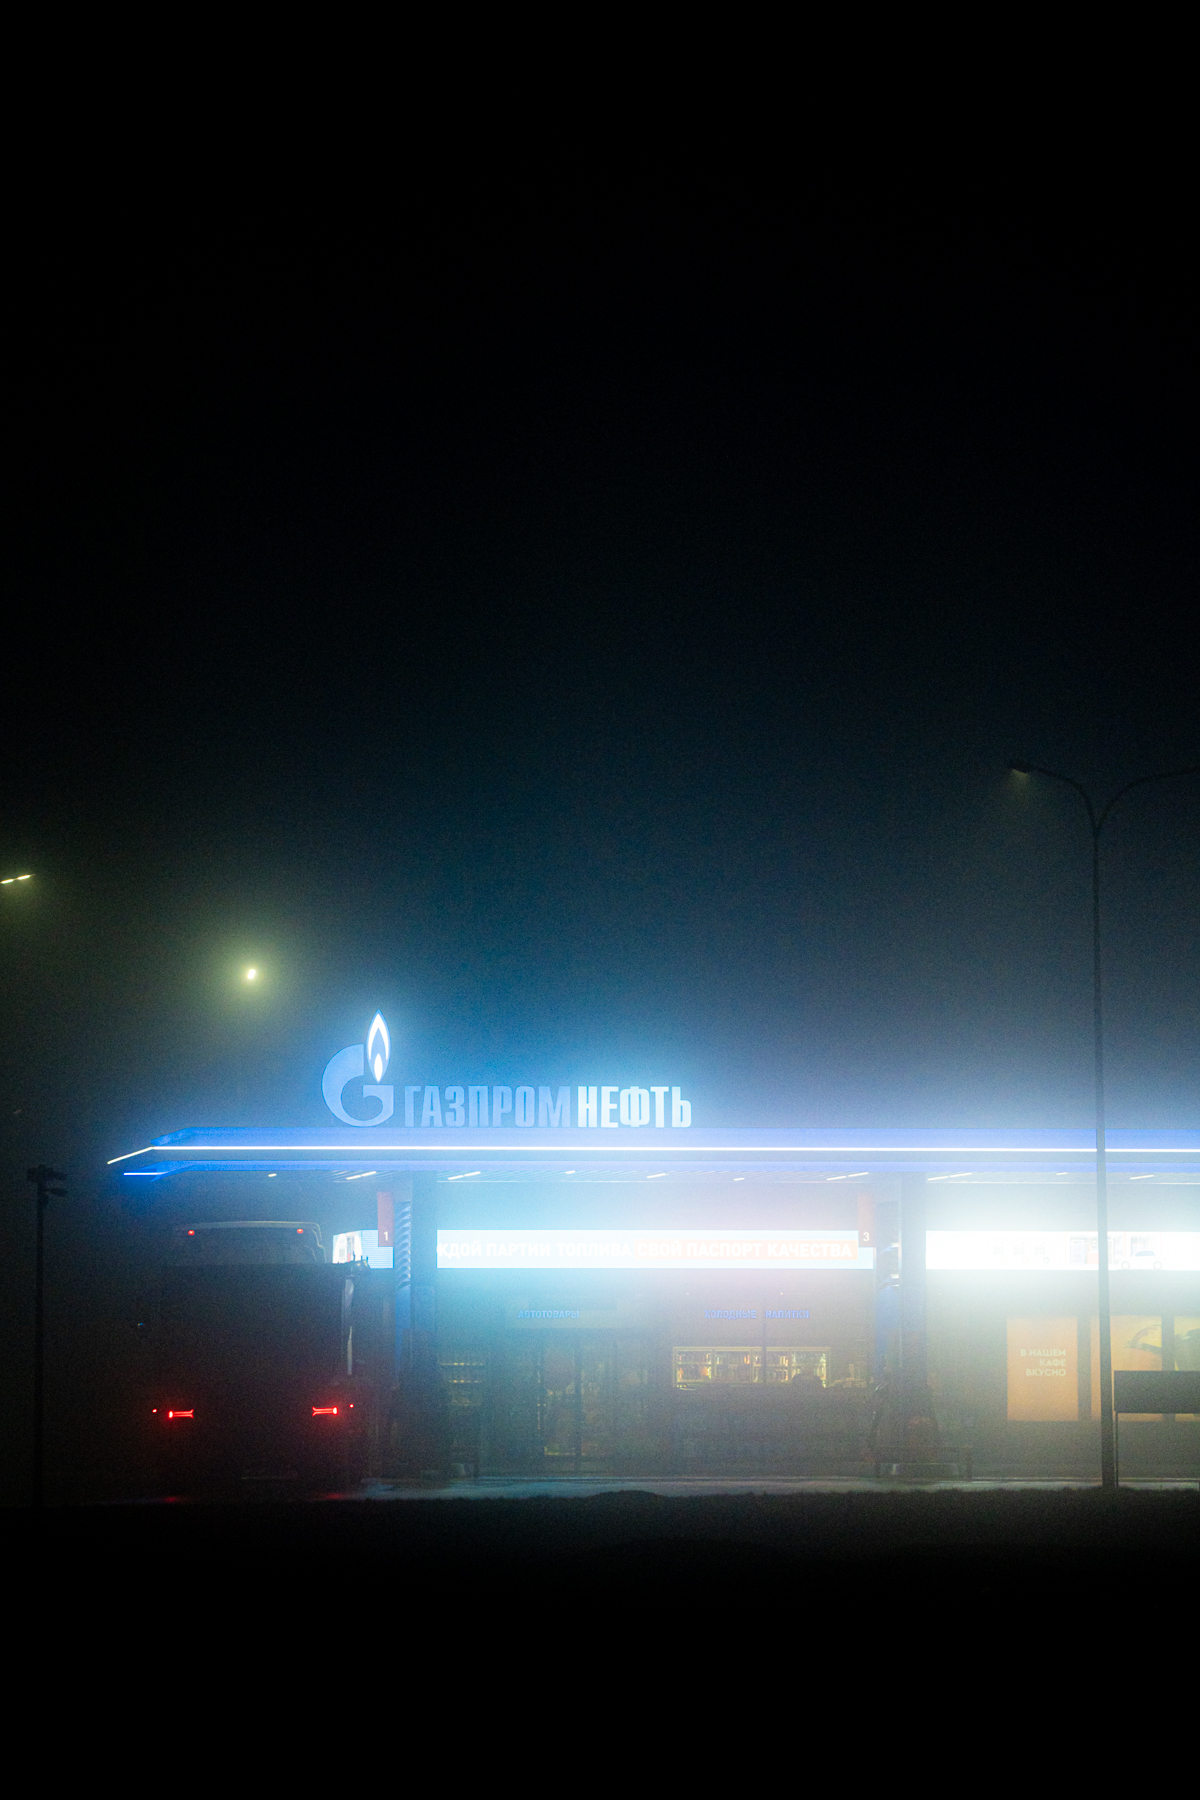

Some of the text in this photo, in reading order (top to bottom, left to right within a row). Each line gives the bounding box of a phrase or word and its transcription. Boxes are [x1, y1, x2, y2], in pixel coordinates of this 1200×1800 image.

[383, 1231, 389, 1241] 1
[863, 1231, 870, 1242] 3
[486, 1243, 551, 1257] ПАРТИИ
[555, 1243, 632, 1257] ТОПЛИВА
[637, 1240, 682, 1257] СВОЙ
[687, 1243, 763, 1257] ПАСПОРТ
[767, 1243, 853, 1257] КАЧЕСТВА
[517, 1309, 580, 1319] АВТОТОВАРЫ
[704, 1309, 810, 1320] ХОЛОДНЫЕ НАПИТКИ
[1029, 1348, 1066, 1356] НАШЕМ
[1039, 1358, 1066, 1367] КАФЕ
[1025, 1368, 1066, 1377] ВКУСНО
